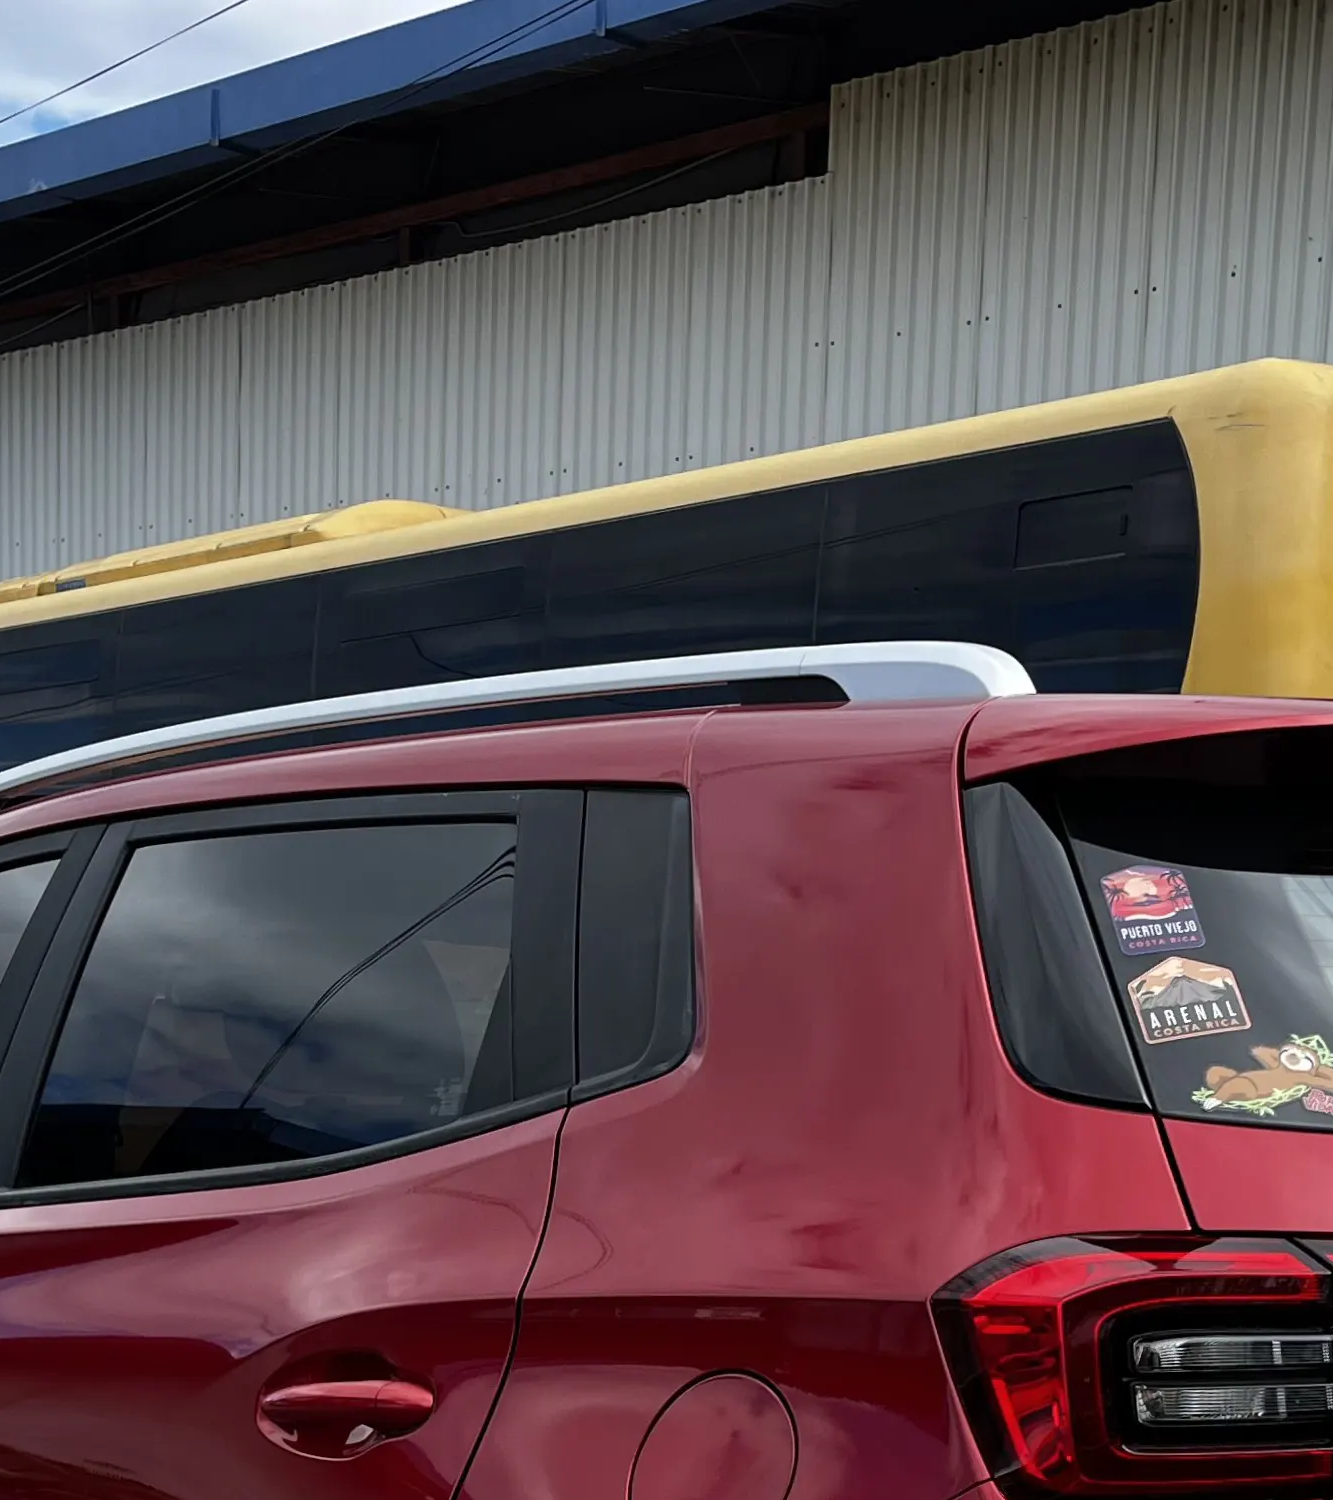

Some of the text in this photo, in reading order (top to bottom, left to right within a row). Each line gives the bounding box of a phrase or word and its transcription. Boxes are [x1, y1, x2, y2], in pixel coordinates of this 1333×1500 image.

[1120, 919, 1198, 940] PUERTO VIEJO
[1128, 935, 1198, 949] COSTA RICA
[1149, 1000, 1237, 1029] ARENAL
[1153, 1018, 1240, 1037] COSTA RICA
